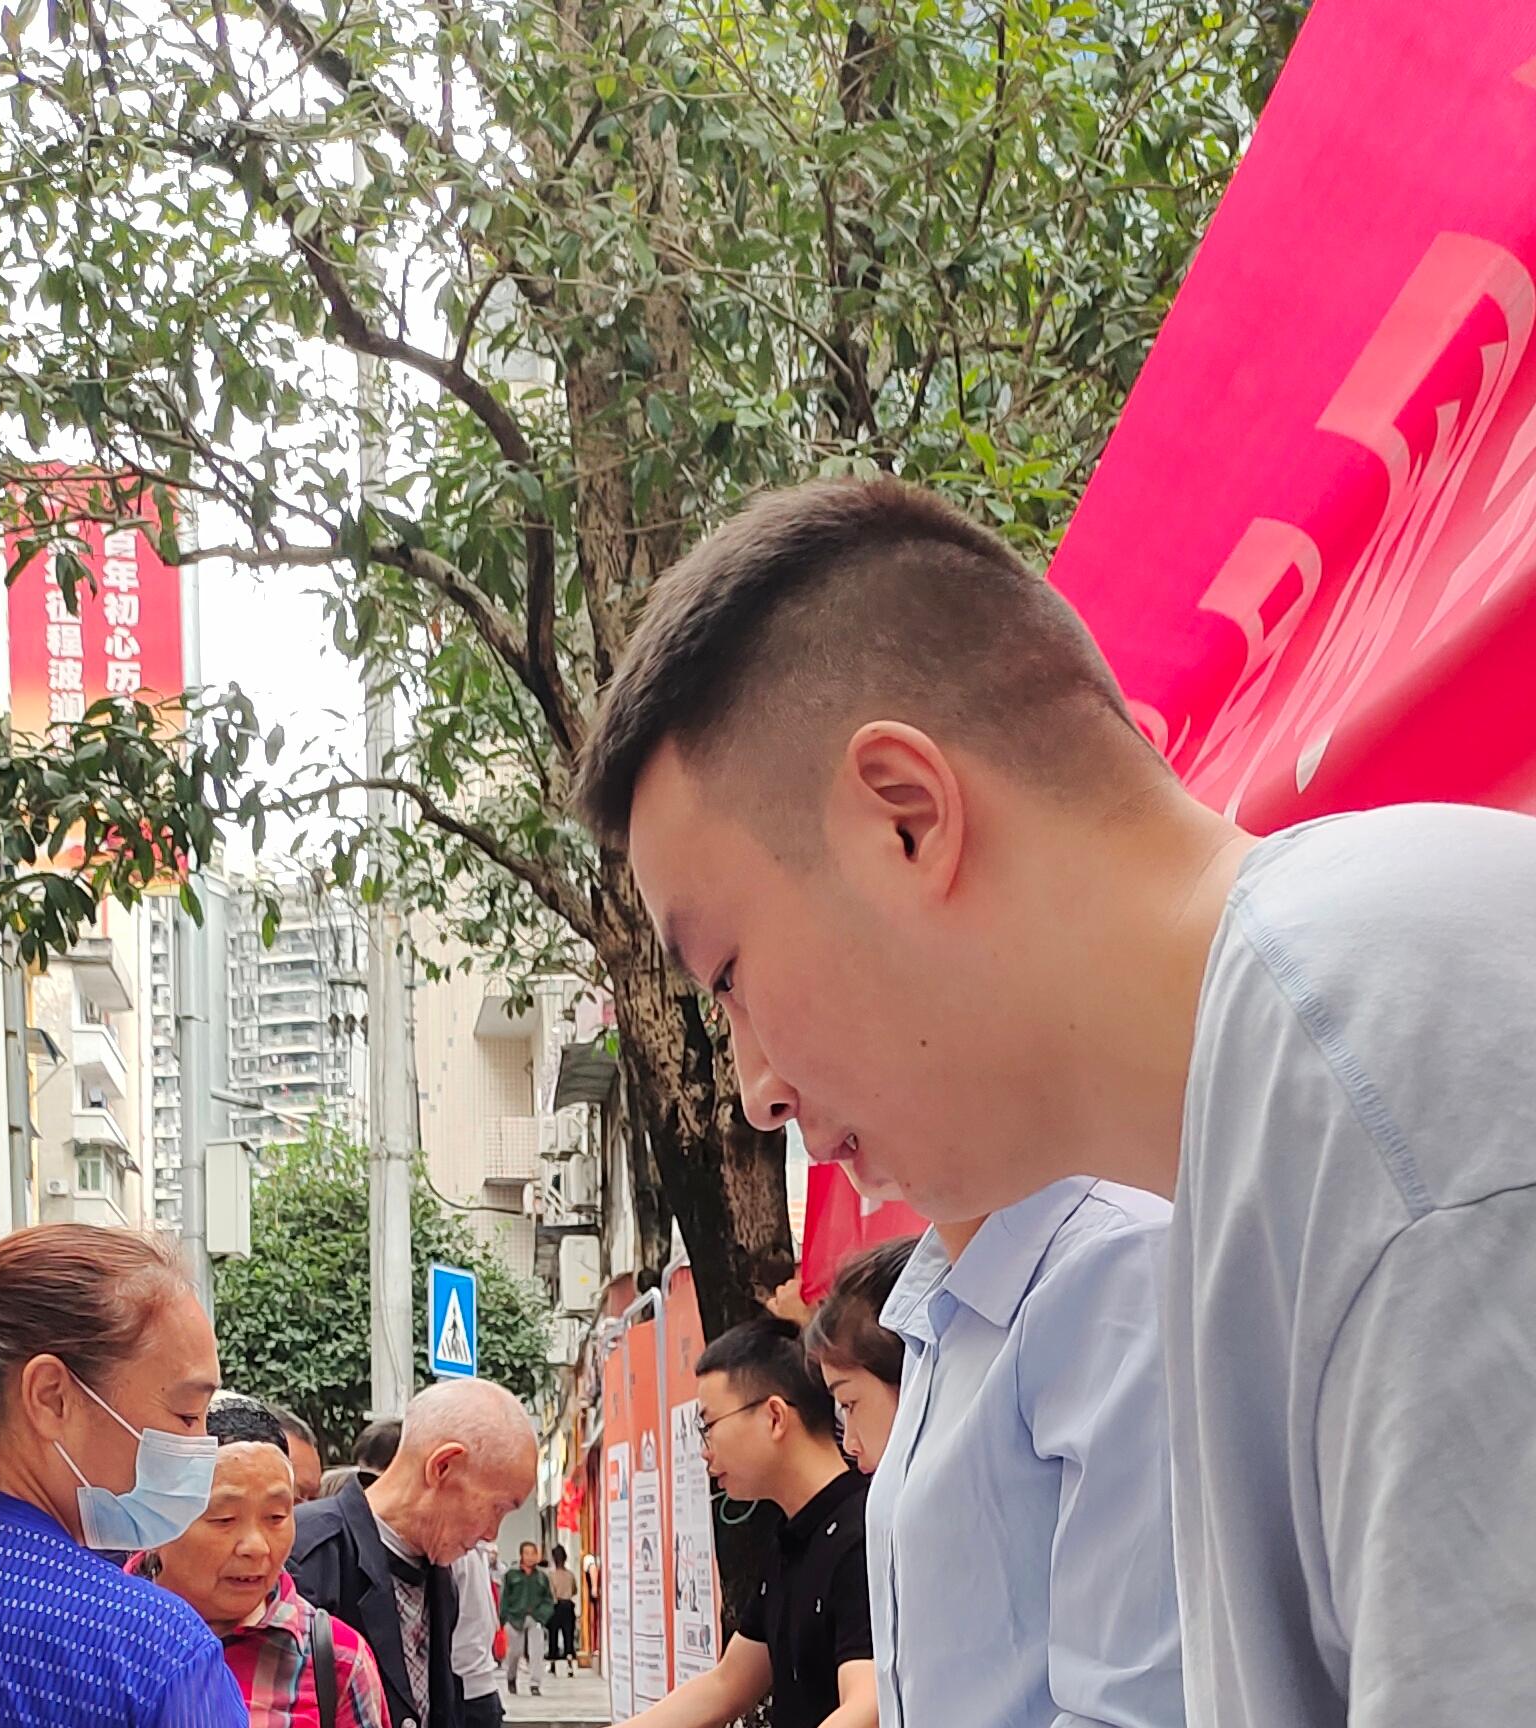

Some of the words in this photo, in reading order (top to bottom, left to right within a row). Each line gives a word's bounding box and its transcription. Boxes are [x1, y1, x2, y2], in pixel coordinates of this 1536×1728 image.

[102, 523, 145, 712] 百年初心历
